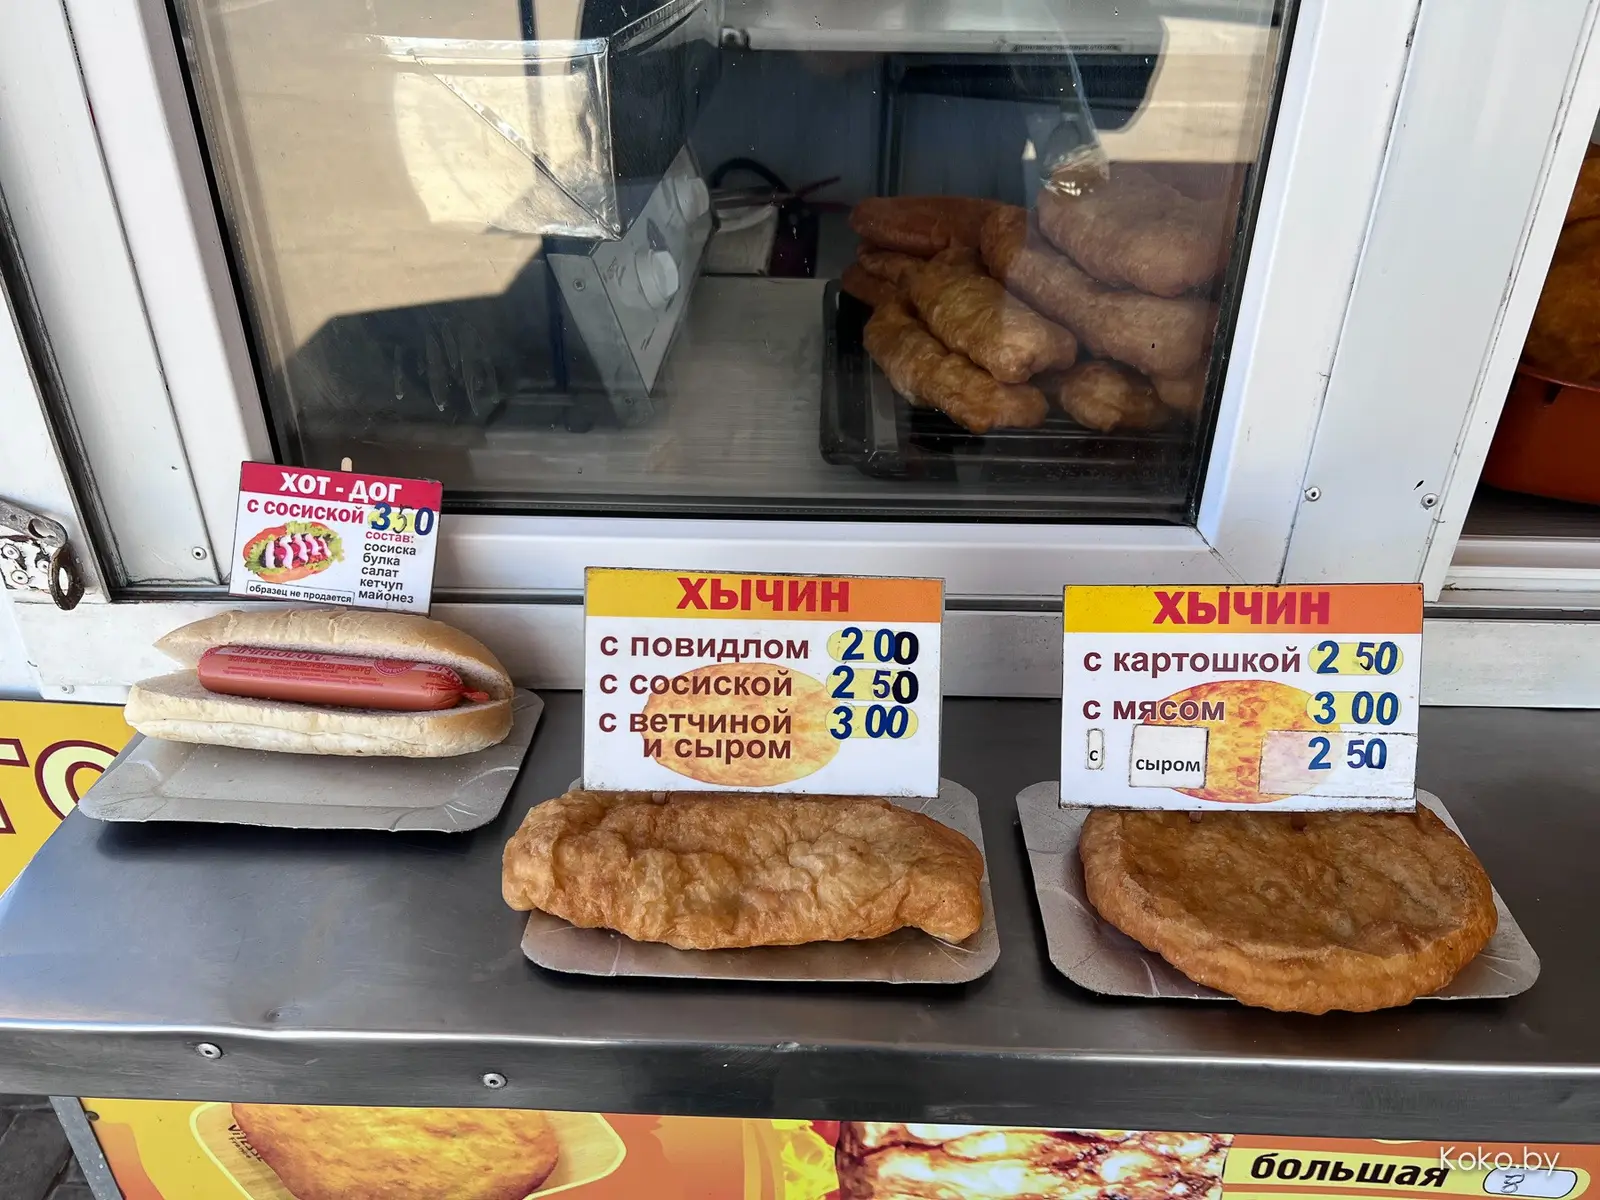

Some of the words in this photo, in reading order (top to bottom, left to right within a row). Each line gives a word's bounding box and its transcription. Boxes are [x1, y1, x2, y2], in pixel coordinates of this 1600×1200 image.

[279, 472, 331, 496] ХОТ
[348, 480, 402, 504] ДОГ
[364, 543, 417, 556] сосиска
[365, 530, 415, 544] состав:
[361, 566, 399, 578] салат
[363, 553, 401, 566] булка
[249, 584, 288, 597] образец
[290, 590, 301, 598] не
[303, 591, 352, 603] продается
[358, 590, 414, 604] майонез
[360, 578, 403, 591] кетчуп
[676, 577, 849, 612] ХЫЧИН
[1152, 591, 1330, 625] ХЫЧИН
[600, 636, 618, 656] с
[631, 636, 809, 662] повидлом
[1083, 651, 1101, 672] с
[1113, 646, 1301, 678] картошкой
[600, 674, 618, 694] с
[629, 670, 792, 697] сосиской
[599, 713, 616, 733] с
[629, 708, 791, 734] ветчиной
[1082, 700, 1101, 720] с
[1113, 700, 1225, 721] мясом
[644, 739, 661, 758] и
[674, 739, 791, 764] сыром
[1089, 749, 1098, 762] с
[1135, 756, 1201, 775] сыром
[1250, 1152, 1451, 1188] большая
